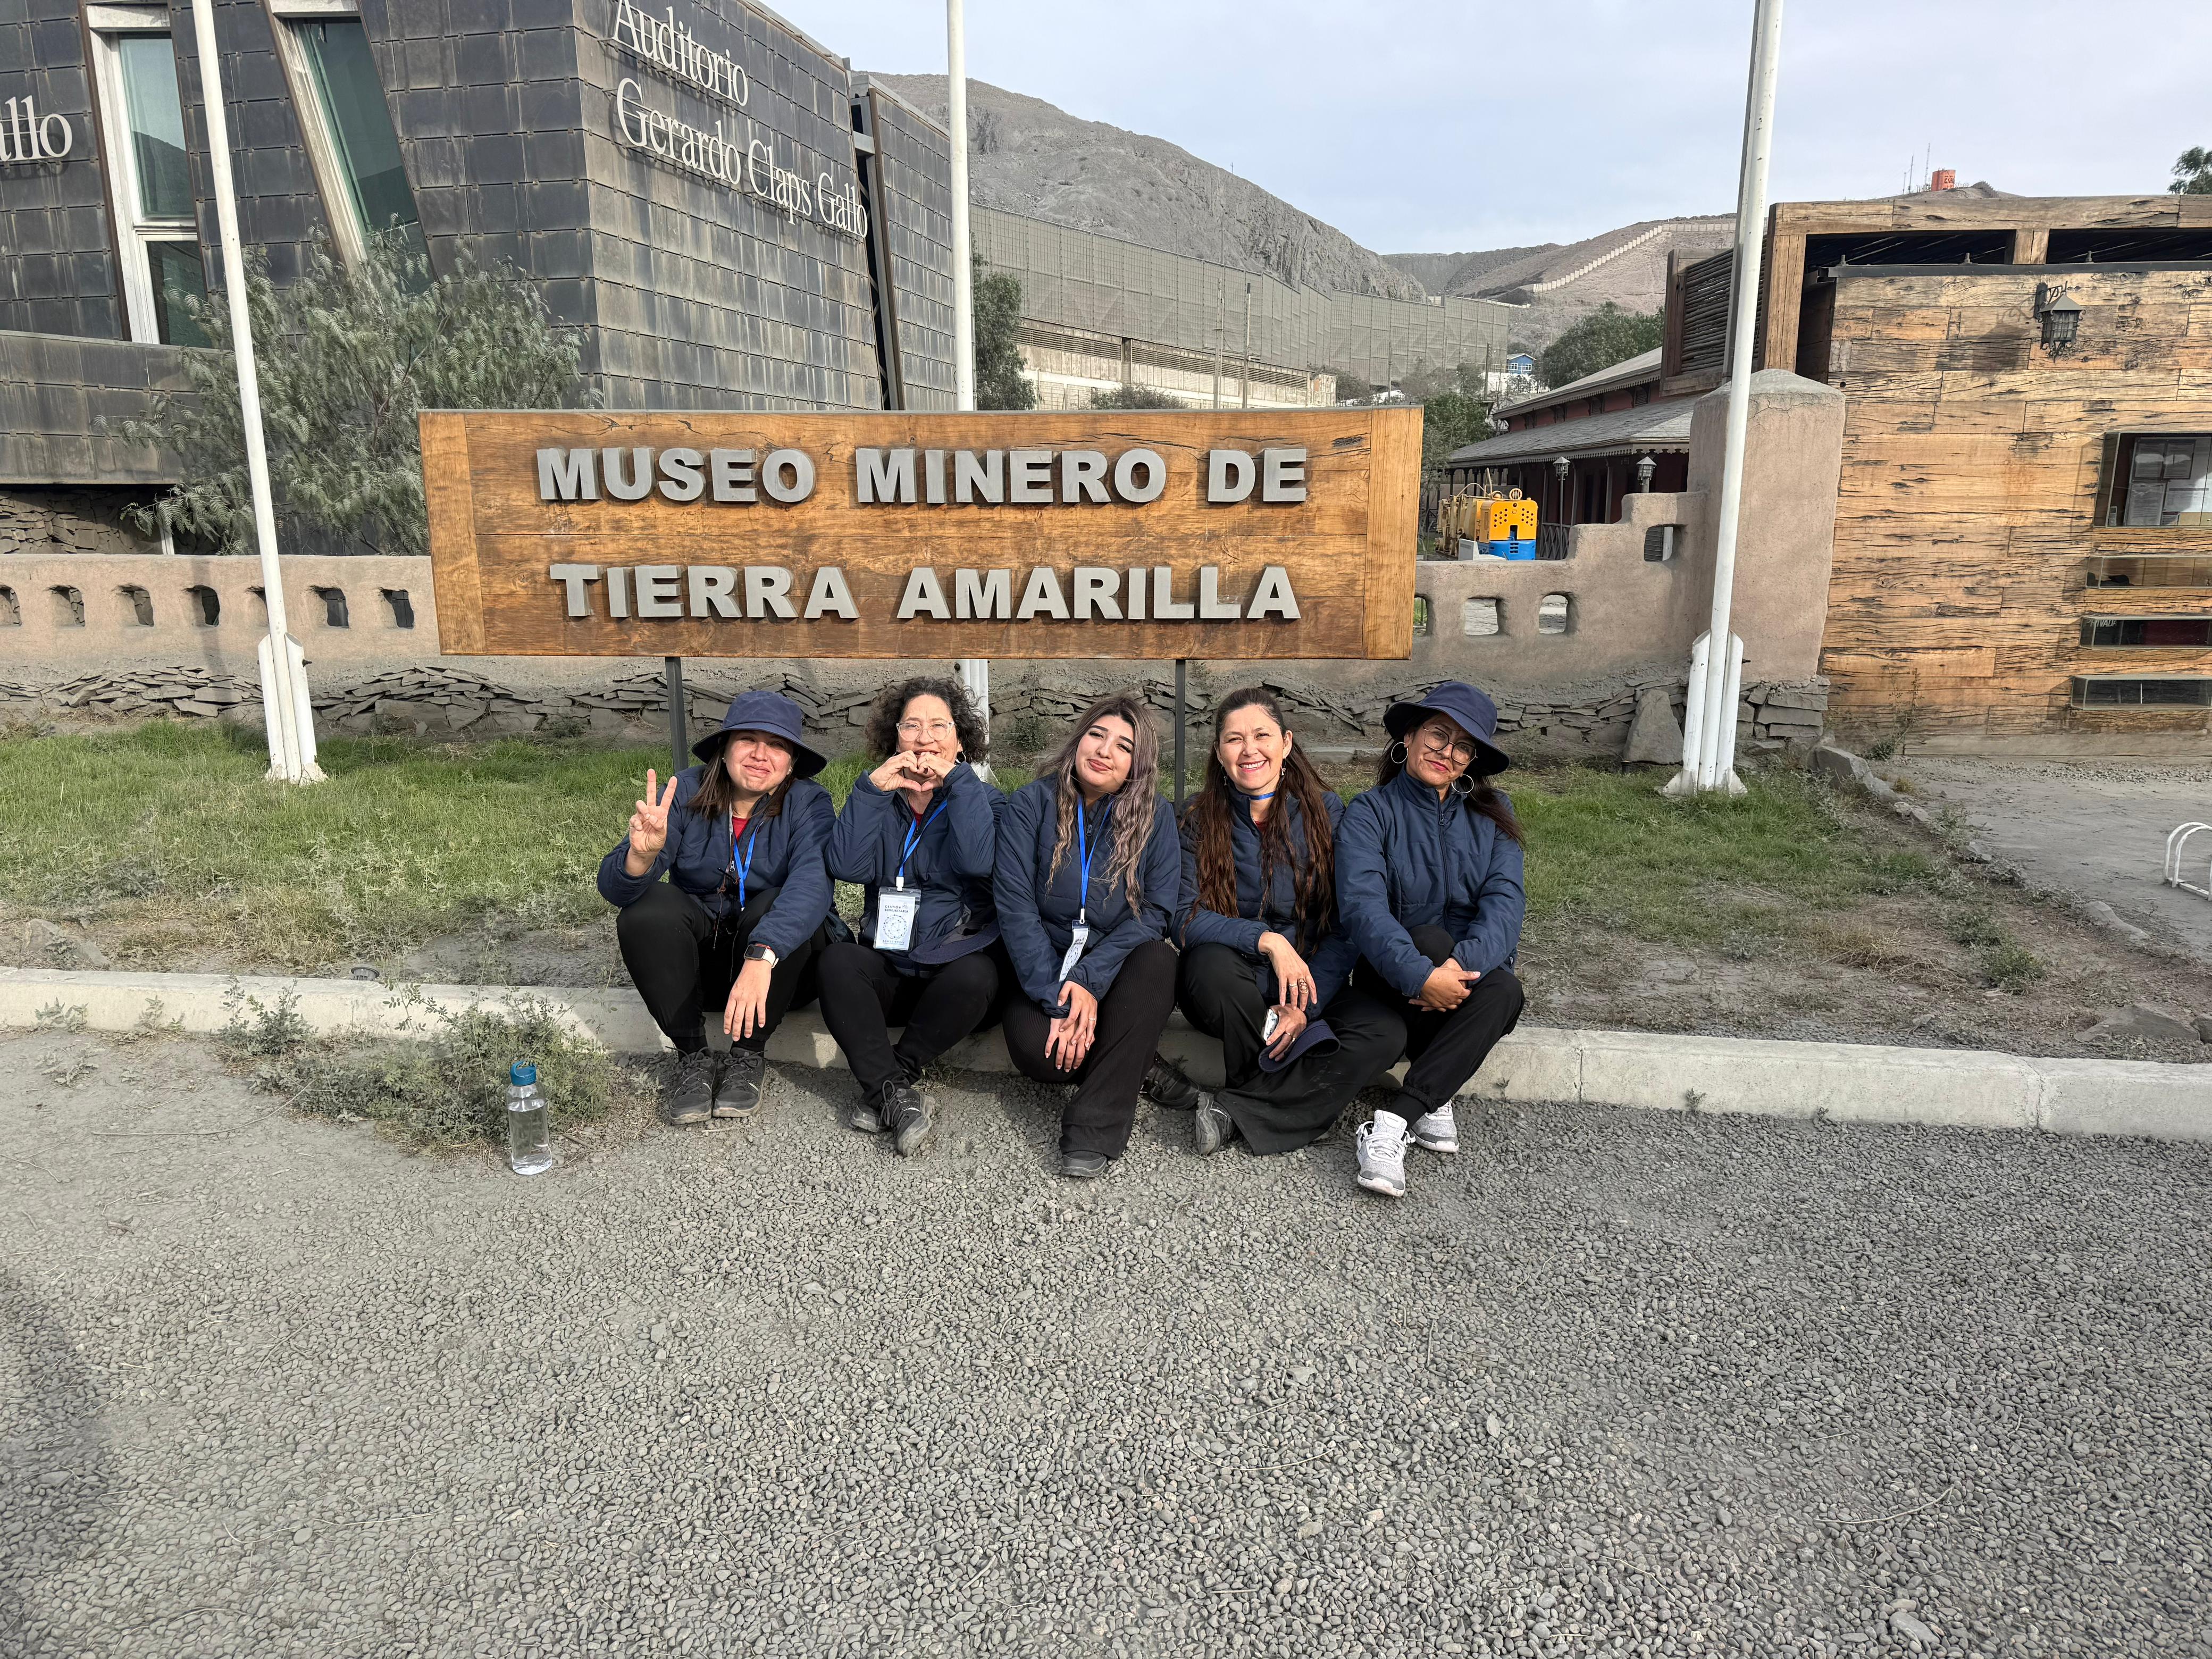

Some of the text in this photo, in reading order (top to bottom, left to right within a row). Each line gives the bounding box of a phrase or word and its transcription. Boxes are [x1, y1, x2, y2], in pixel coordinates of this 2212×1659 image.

[611, 0, 748, 106] Auditorio
[617, 78, 868, 238] Gerardo Claps Gallo
[536, 448, 1306, 503] MUSEO MINERO DE
[549, 564, 1302, 619] TIERRA AMARILLA
